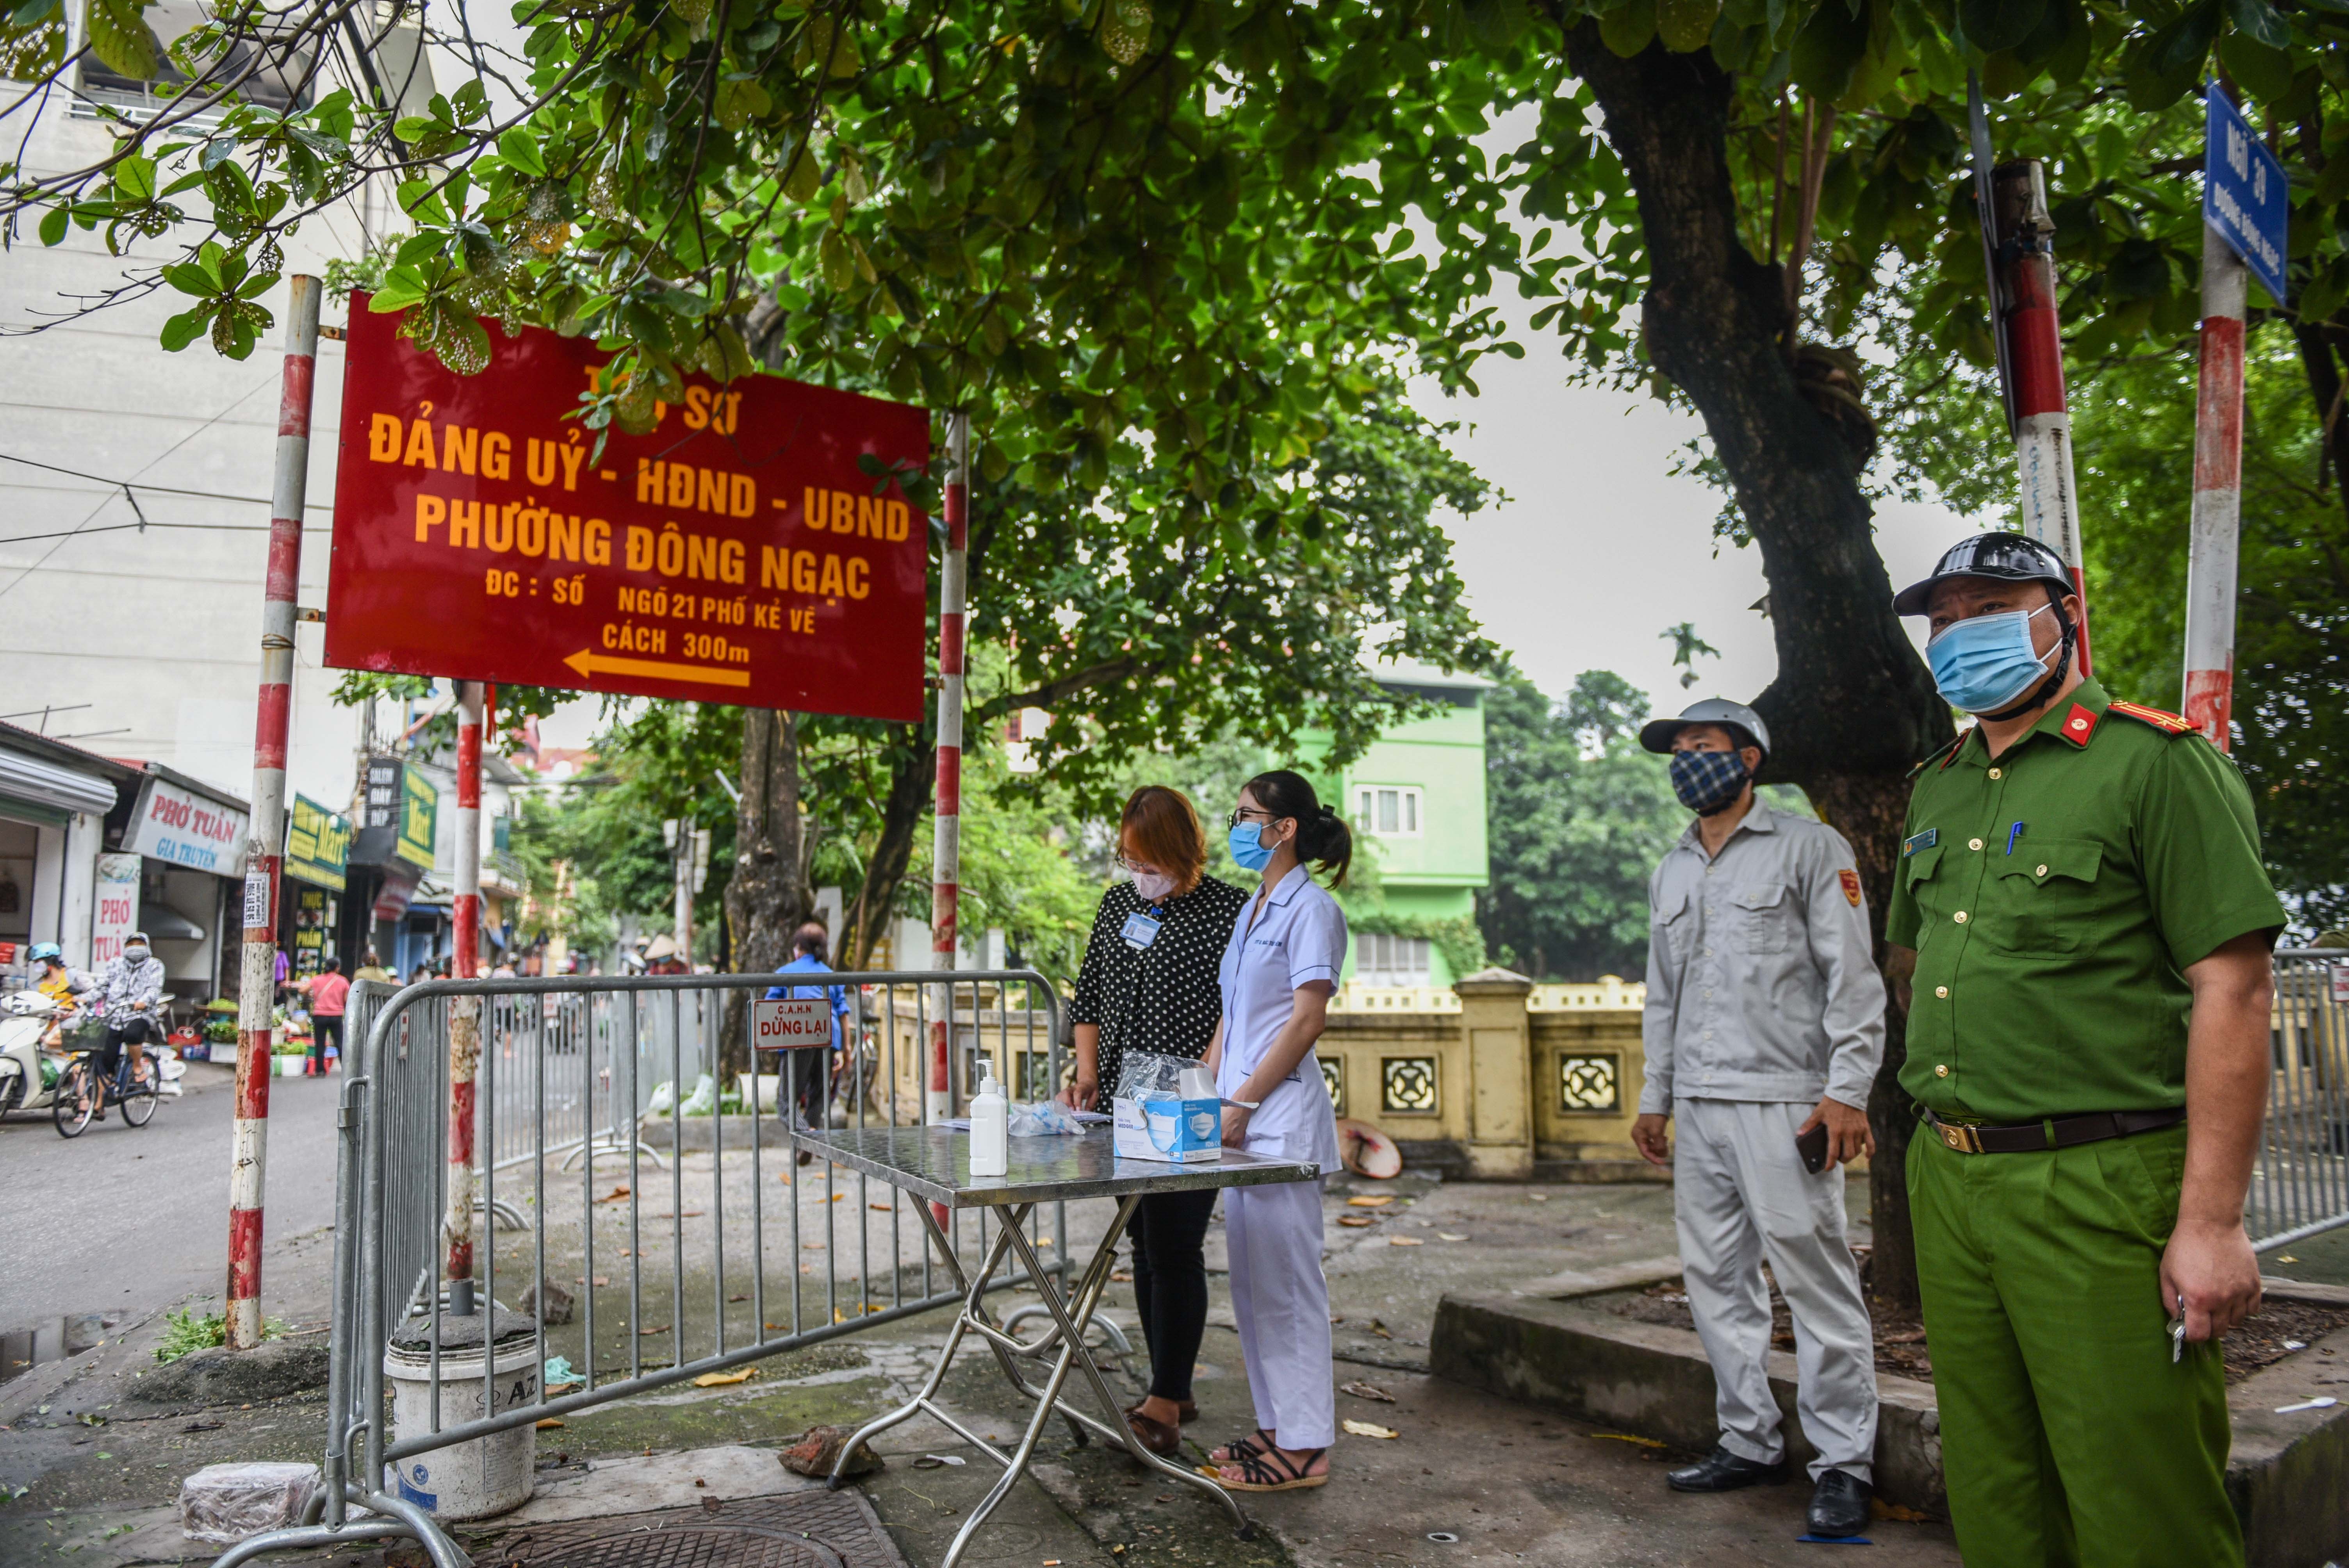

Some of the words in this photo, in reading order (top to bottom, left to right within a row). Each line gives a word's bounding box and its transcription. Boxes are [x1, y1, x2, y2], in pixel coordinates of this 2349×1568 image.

[368, 400, 512, 481] ĐẢNG
[526, 428, 586, 492] UỶ
[637, 458, 756, 518] HĐND
[804, 487, 909, 542] UBND
[415, 494, 612, 566] PHƯỜNG
[625, 521, 745, 584] ĐÔNG
[761, 545, 870, 607] NGẠC
[485, 568, 520, 598] ĐC
[552, 574, 586, 606] SỐ
[618, 586, 668, 617] NGÕ
[672, 593, 695, 619] 21
[702, 595, 747, 625] PHỐ
[754, 598, 781, 630] KẺ
[602, 619, 667, 654] CÁCH
[683, 632, 749, 663] 300m
[151, 793, 192, 829] PHỞ
[157, 837, 176, 859] GIA
[100, 888, 131, 925] PHỞ
[761, 1016, 802, 1036] DỪNG
[806, 1020, 827, 1037] LẠI
[778, 1005, 811, 1014] C.A.H.N
